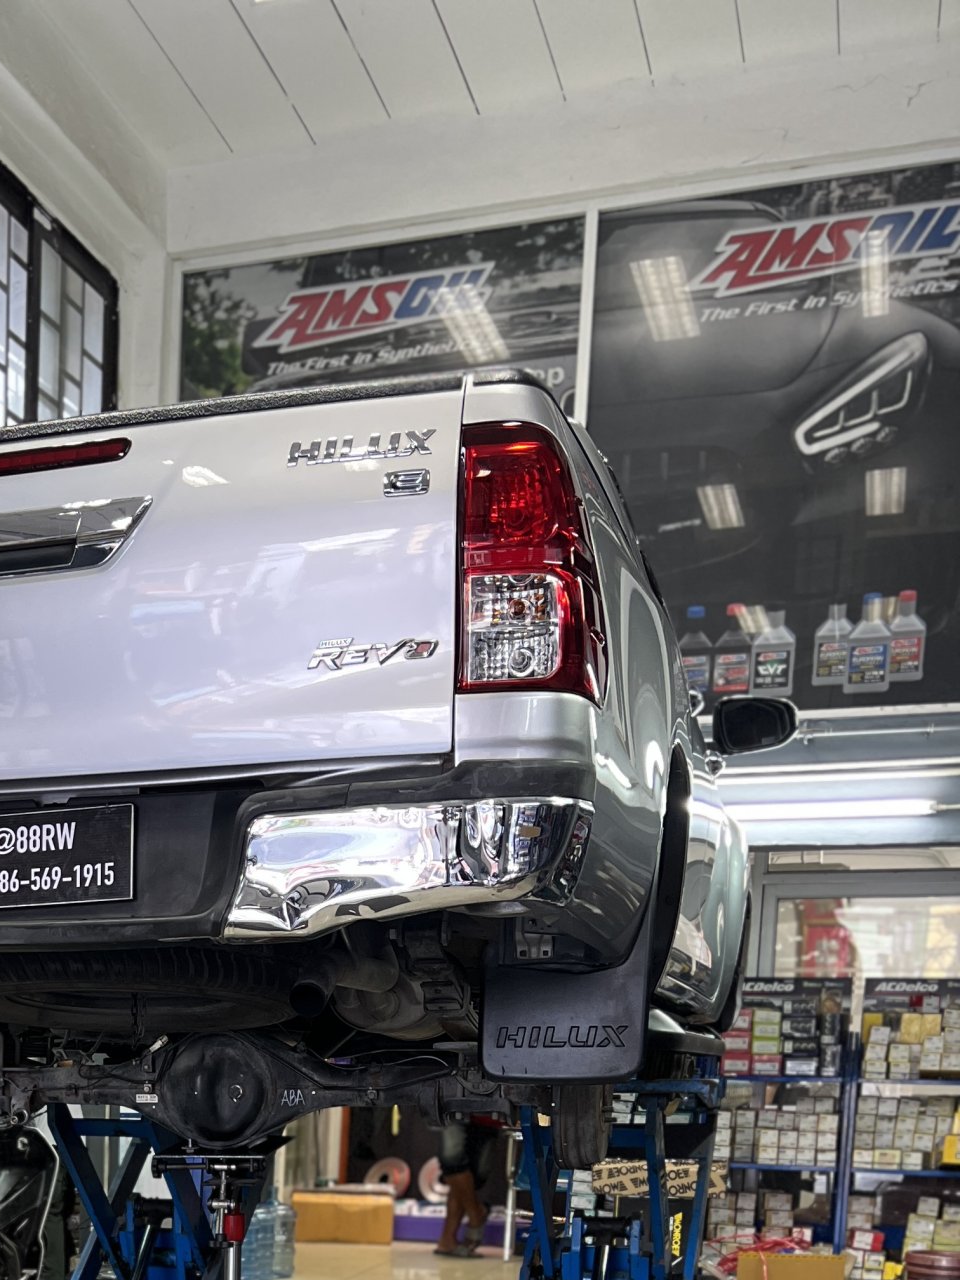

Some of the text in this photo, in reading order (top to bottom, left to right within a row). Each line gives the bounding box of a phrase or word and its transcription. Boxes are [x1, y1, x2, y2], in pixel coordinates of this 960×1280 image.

[699, 306, 739, 323] The
[744, 297, 800, 318] First
[803, 294, 827, 310] in
[267, 359, 301, 376] The
[302, 350, 349, 372] First
[354, 350, 372, 366] in
[287, 429, 437, 468] HILUX
[307, 638, 439, 671] REVO
[319, 637, 353, 649] HILUX
[758, 663, 787, 678] CVT
[874, 981, 939, 992] ACDelco
[496, 1025, 629, 1048] HILUX
[280, 1088, 306, 1107] ABA
[671, 1212, 683, 1257] MONROE
